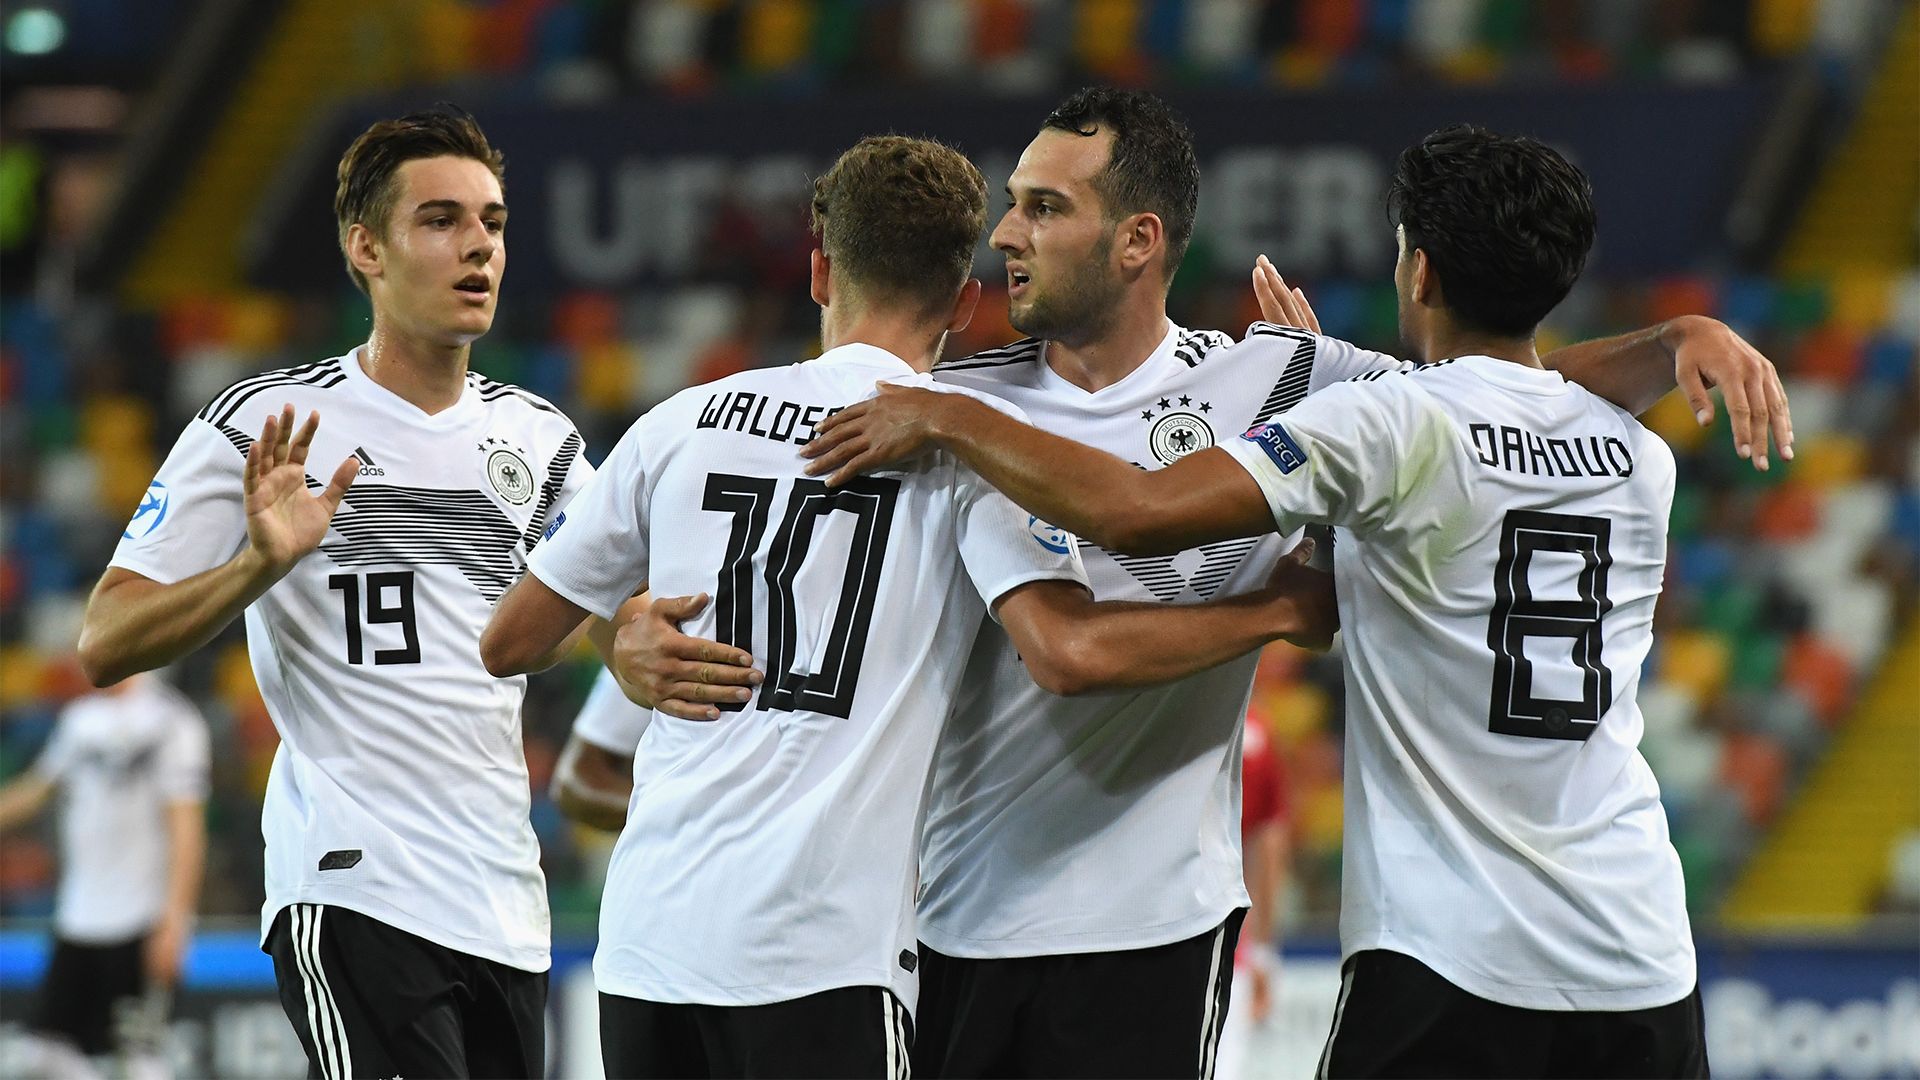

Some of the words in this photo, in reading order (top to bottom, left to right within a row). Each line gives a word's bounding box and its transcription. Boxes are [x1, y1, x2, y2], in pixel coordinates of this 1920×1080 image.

[1161, 418, 1198, 433] DEUTSCHER
[1262, 427, 1300, 468] SPECT
[1469, 424, 1633, 477] DAHOUD
[328, 570, 421, 666] 19
[701, 472, 902, 720] 10
[1487, 509, 1613, 741] 8
